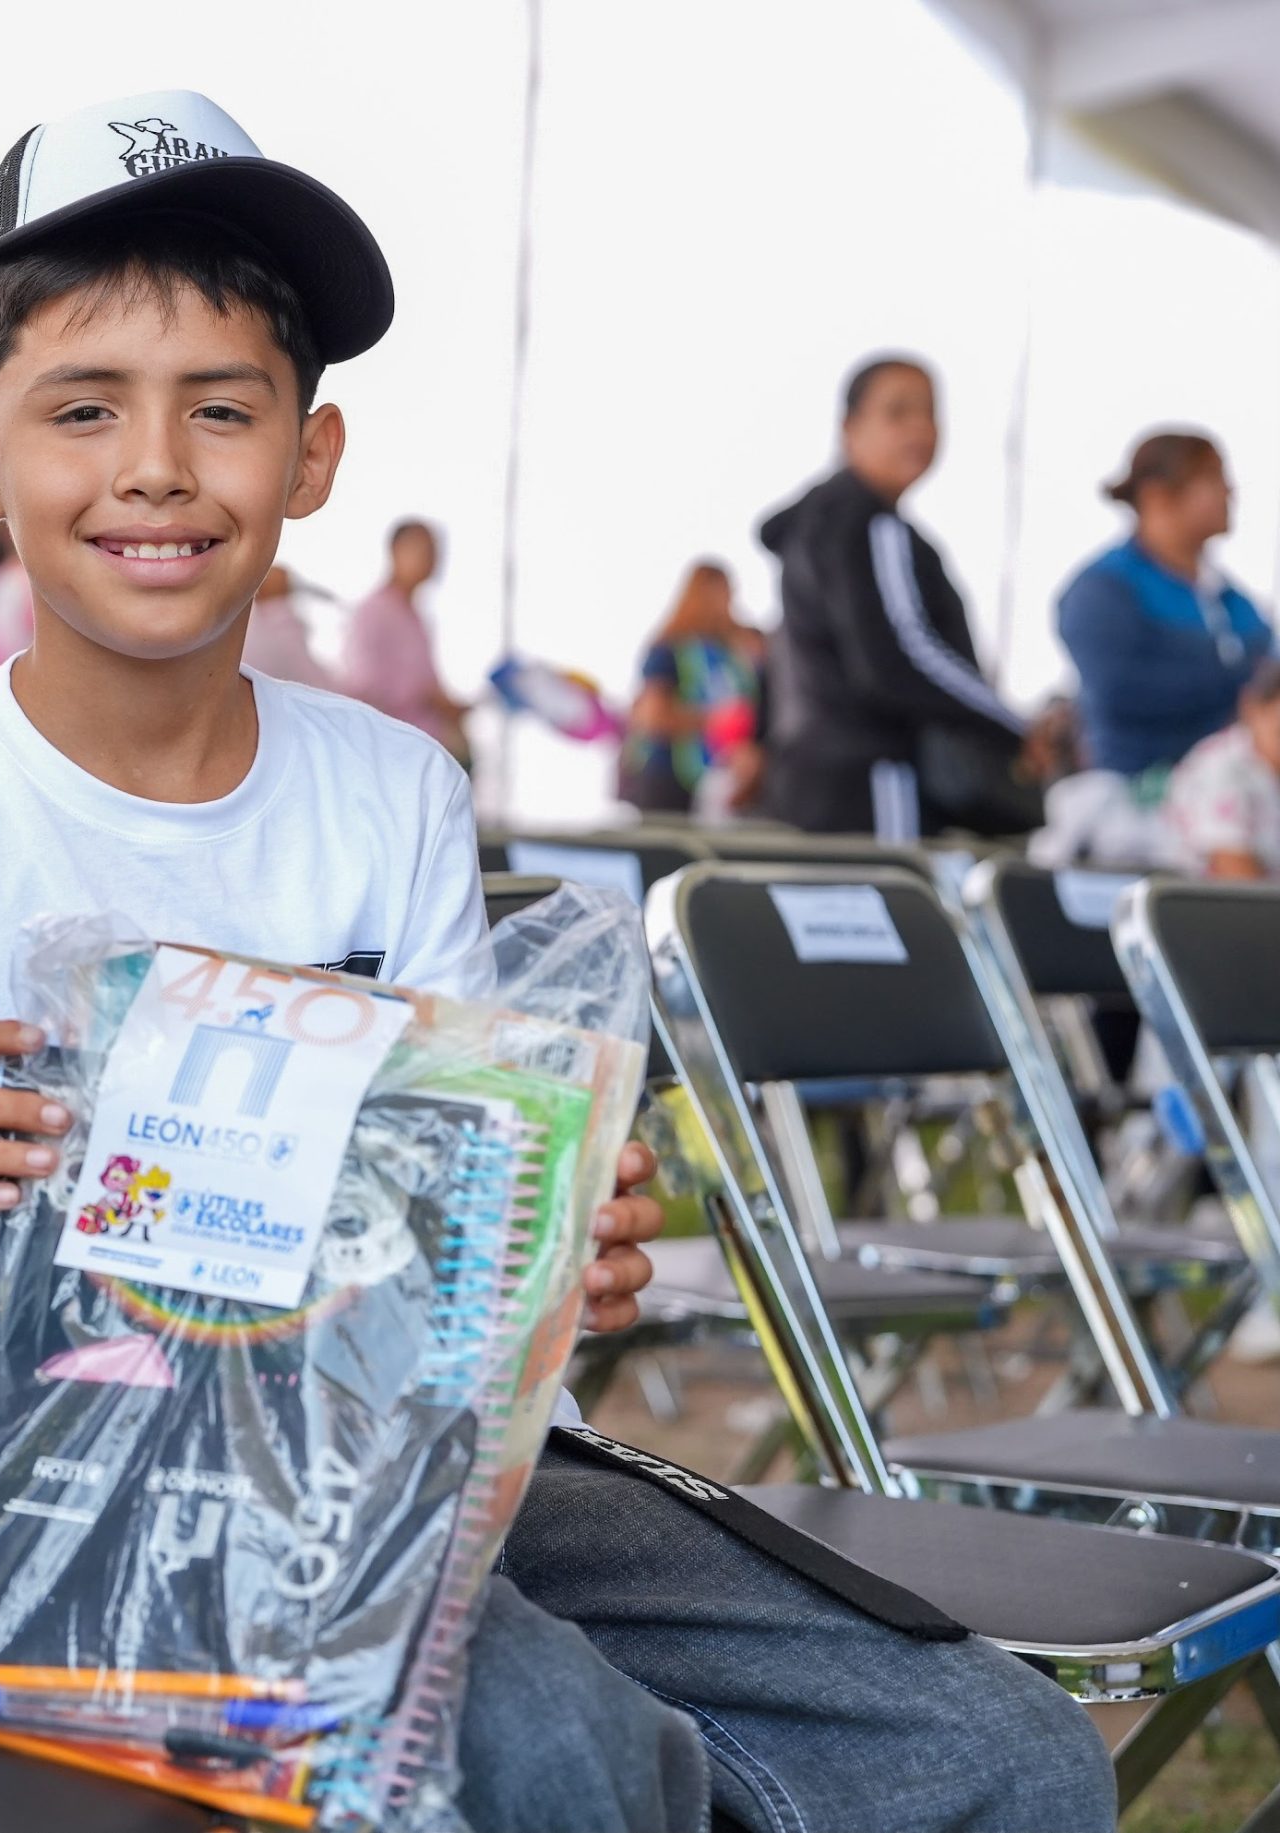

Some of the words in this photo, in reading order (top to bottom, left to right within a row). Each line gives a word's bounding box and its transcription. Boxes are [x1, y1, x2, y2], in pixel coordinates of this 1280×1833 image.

[160, 957, 379, 1046] 450
[195, 1210, 304, 1243] ESCOLARES
[211, 1262, 262, 1289] LEÓN
[272, 1445, 359, 1601] 450
